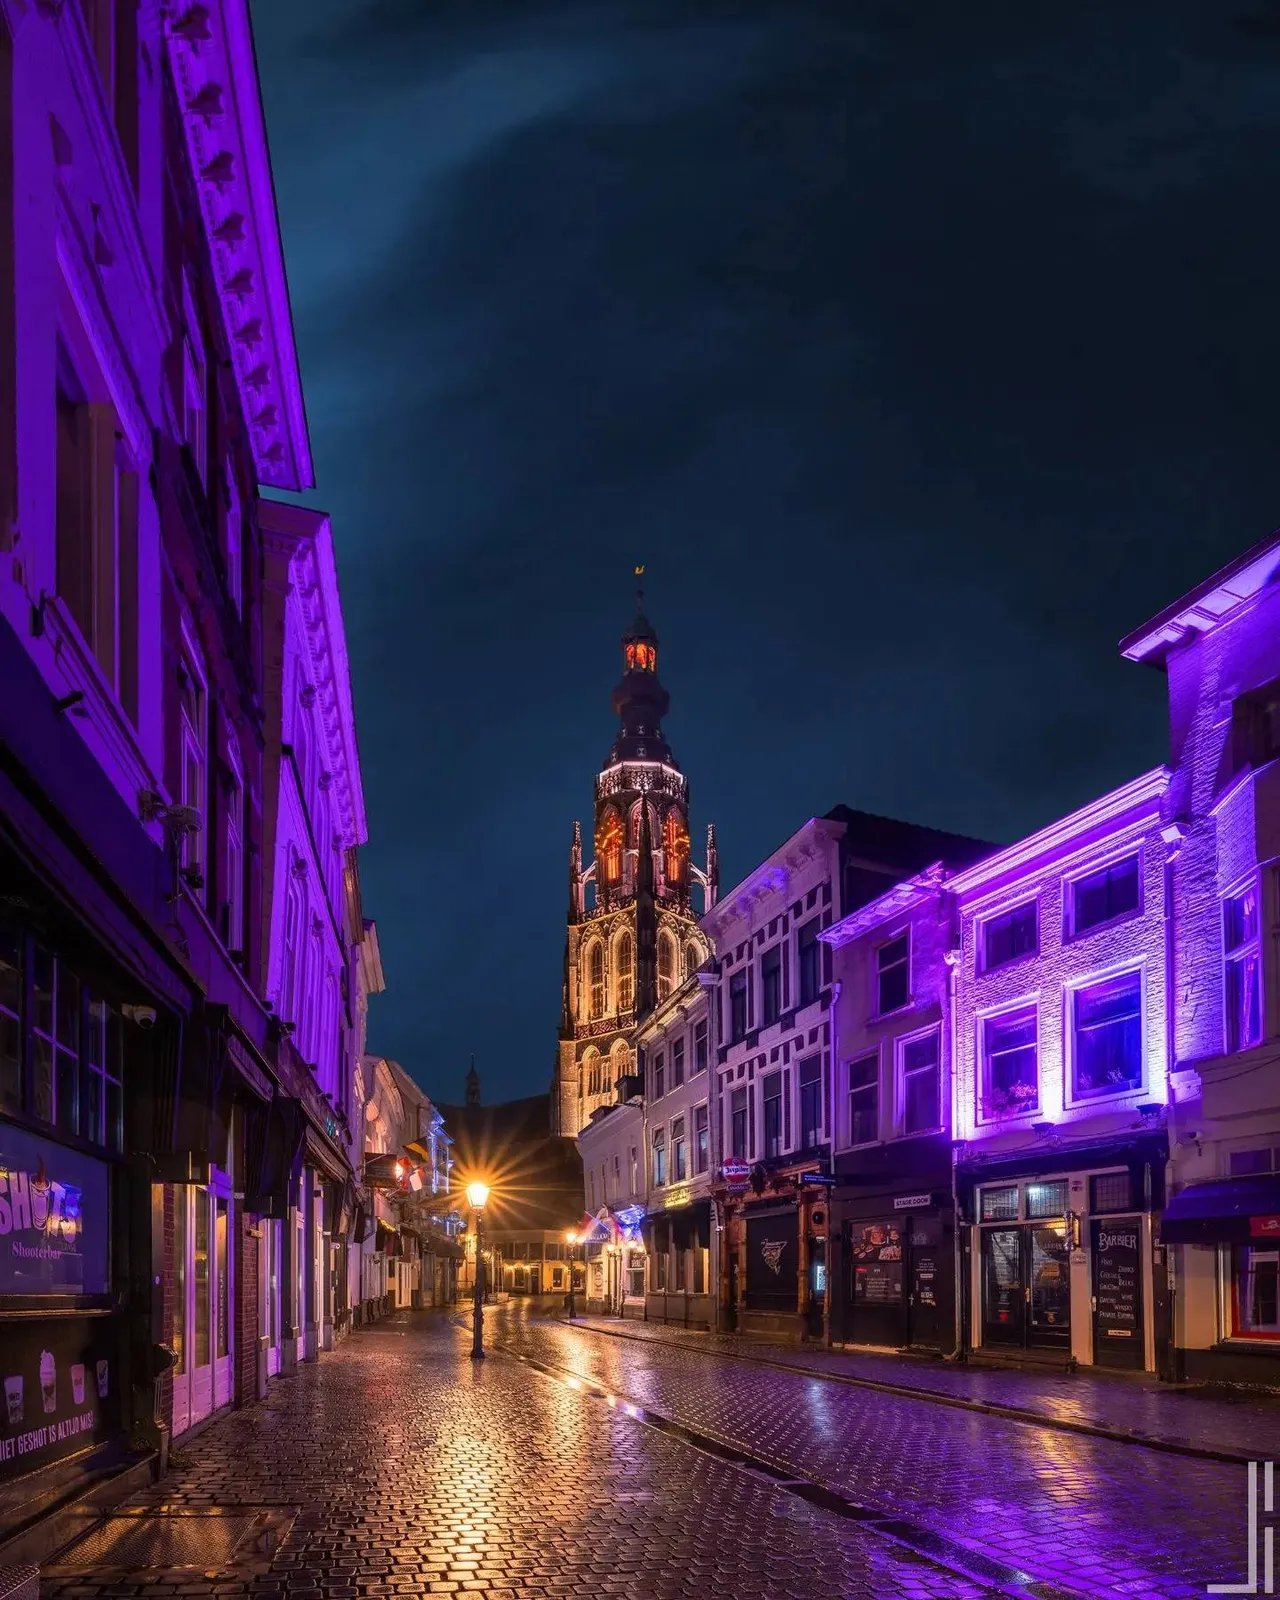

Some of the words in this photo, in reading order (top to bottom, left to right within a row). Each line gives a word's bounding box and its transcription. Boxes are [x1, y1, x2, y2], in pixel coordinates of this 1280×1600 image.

[12, 1241, 61, 1259] Shooterbar
[1099, 1233, 1137, 1251] BARBIER
[18, 1427, 47, 1455] GESHOT
[49, 1425, 56, 1443] IS
[58, 1416, 79, 1440] ALTIJD
